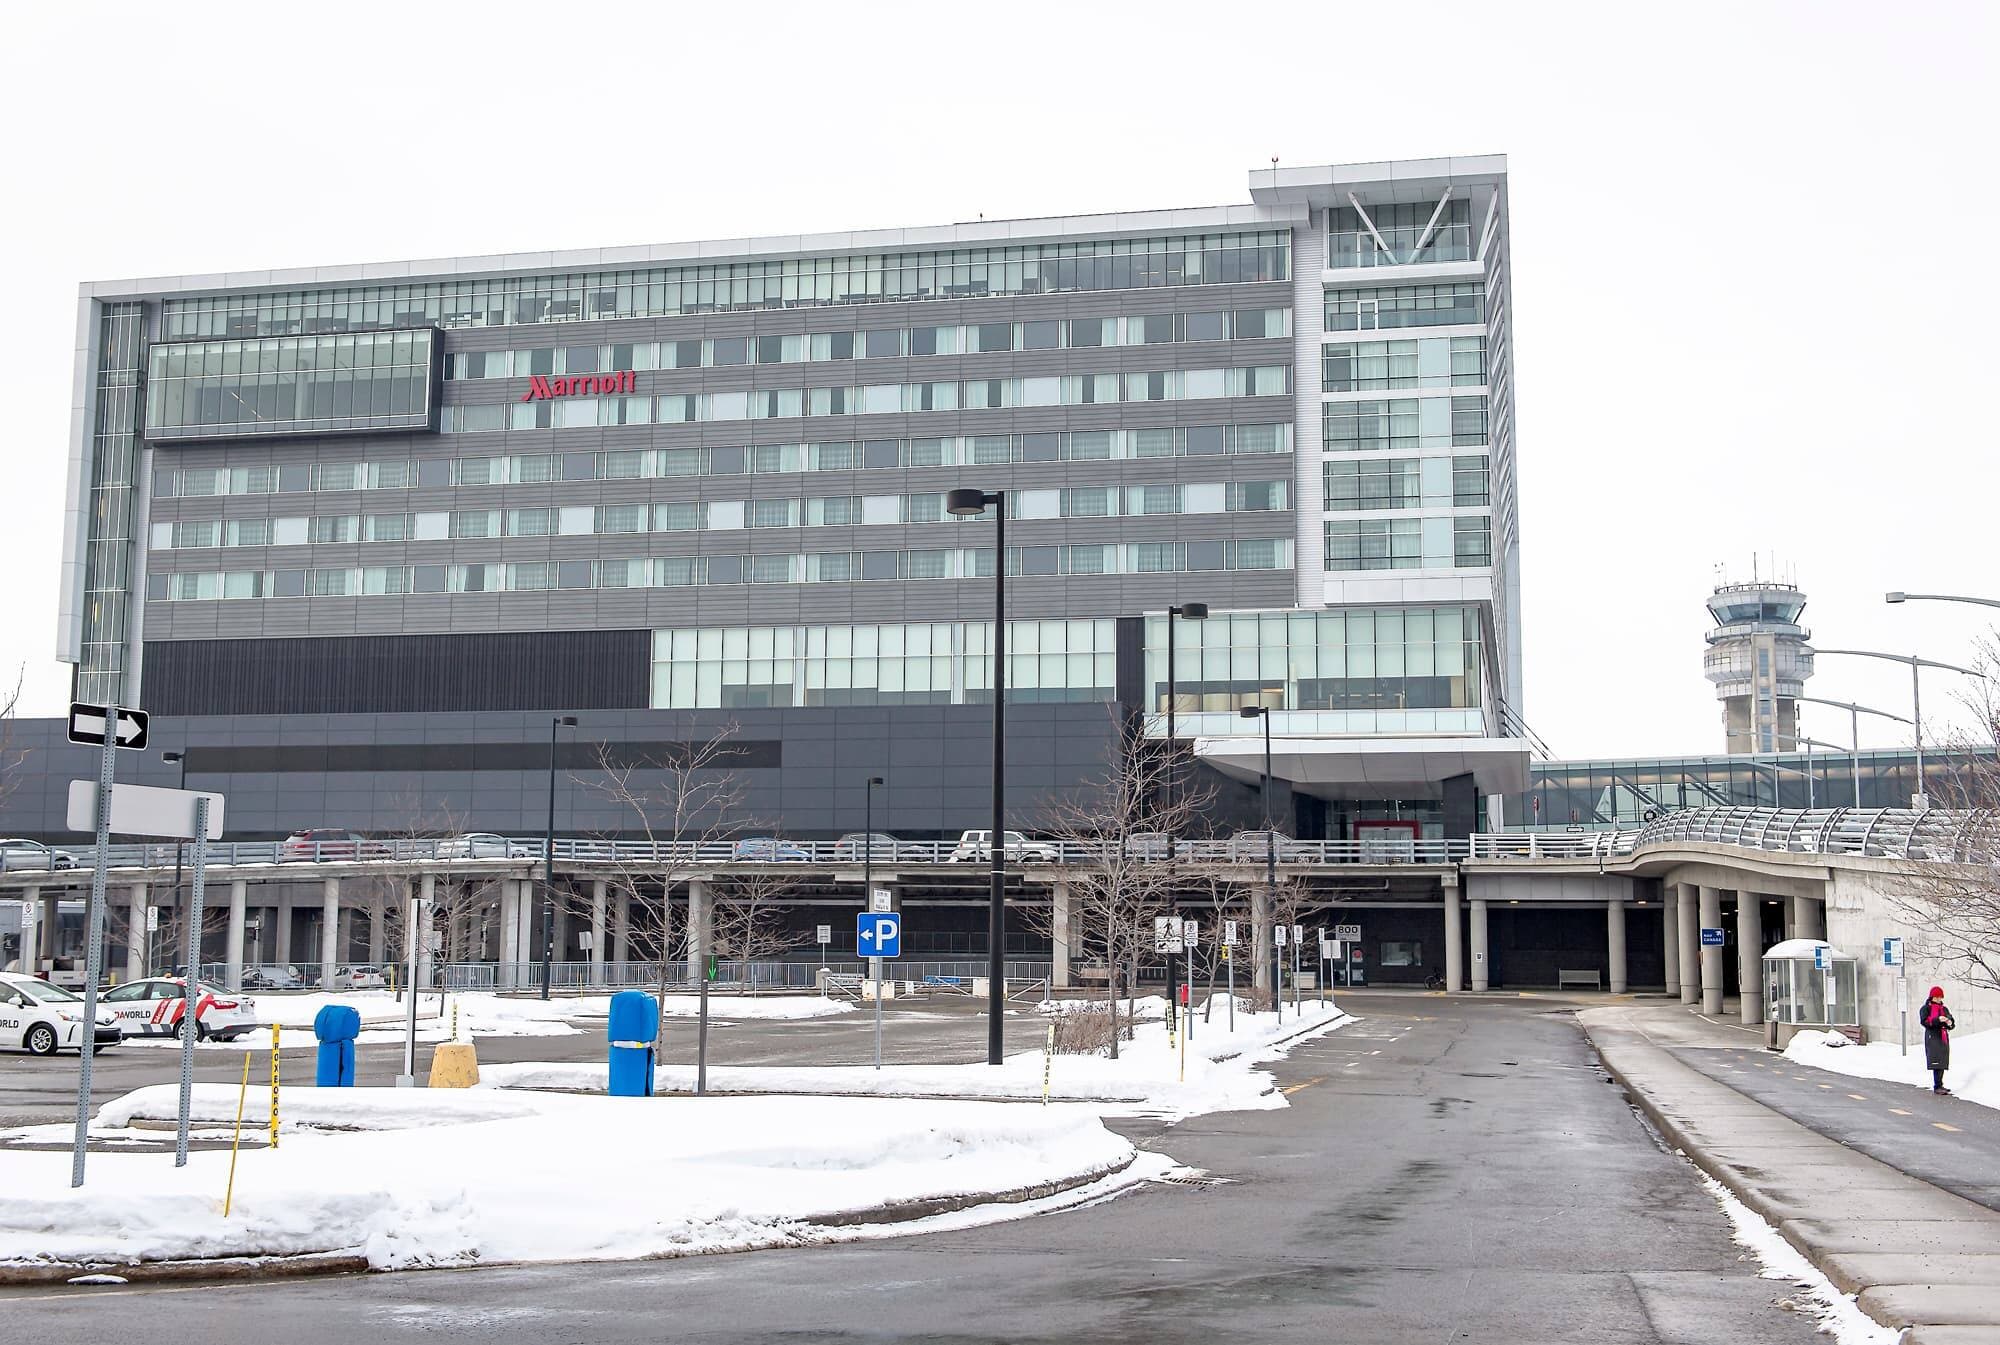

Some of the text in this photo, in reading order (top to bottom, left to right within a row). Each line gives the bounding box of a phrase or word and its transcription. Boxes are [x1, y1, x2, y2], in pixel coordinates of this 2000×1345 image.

[521, 370, 637, 402] Marriott
[876, 920, 898, 950] P
[1338, 926, 1358, 934] 800
